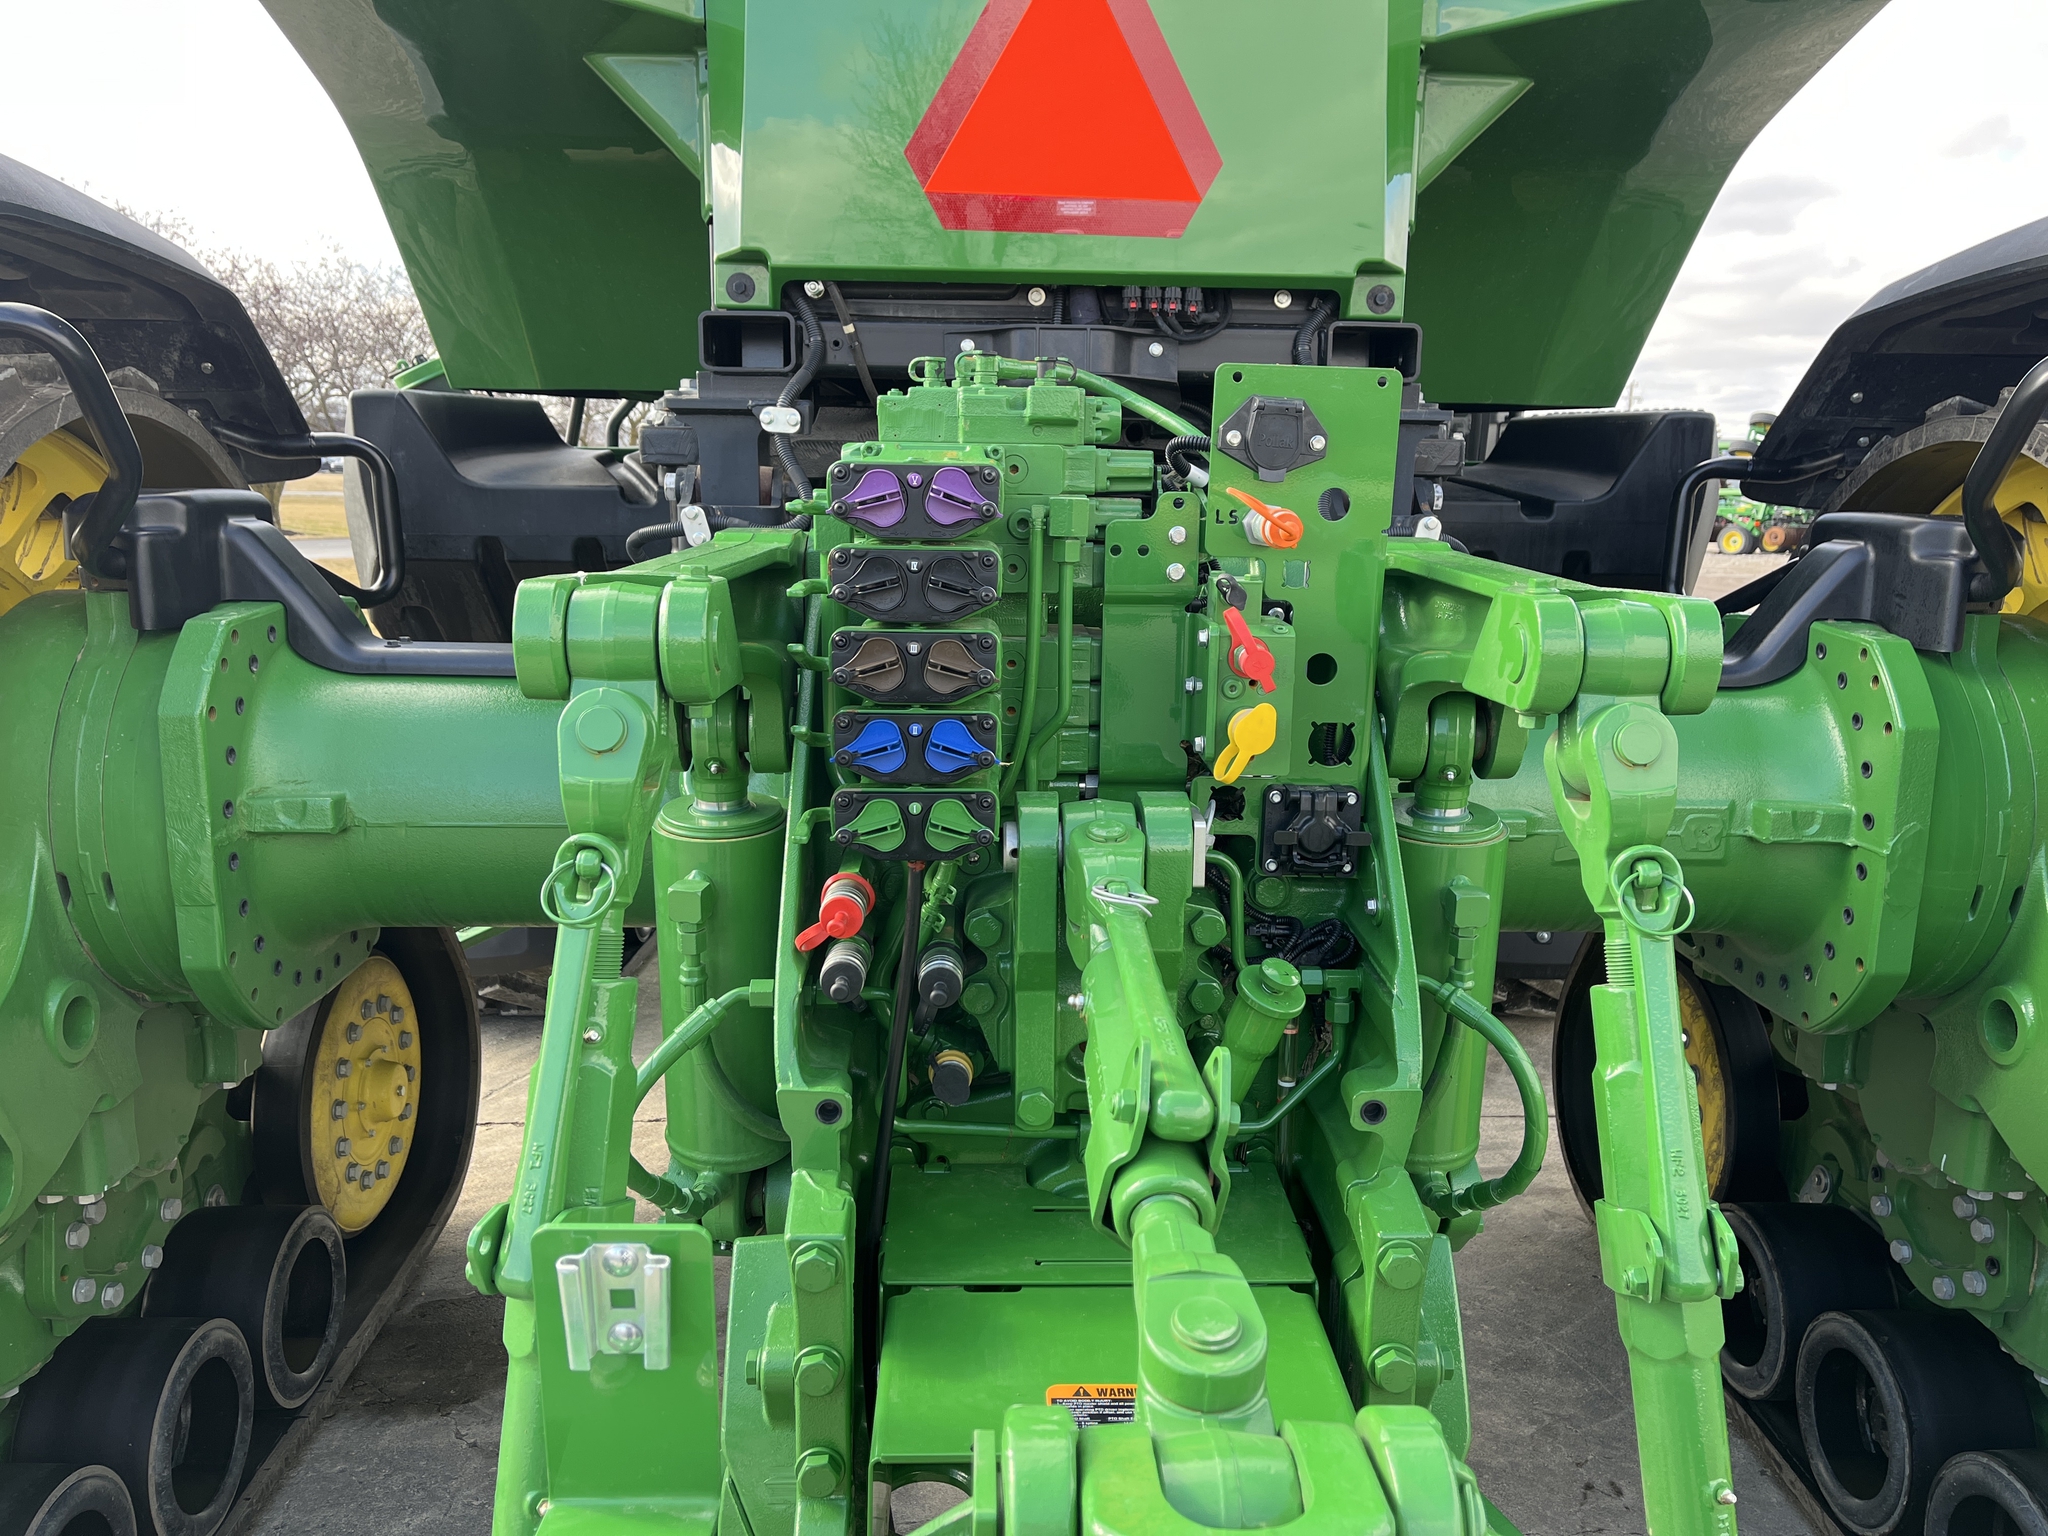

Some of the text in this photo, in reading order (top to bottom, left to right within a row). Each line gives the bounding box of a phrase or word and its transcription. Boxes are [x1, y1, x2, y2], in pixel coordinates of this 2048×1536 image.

[1257, 432, 1294, 449] Pollak
[911, 475, 919, 485] V
[1215, 508, 1240, 525] LS
[910, 561, 919, 571] IV
[909, 643, 918, 653] III
